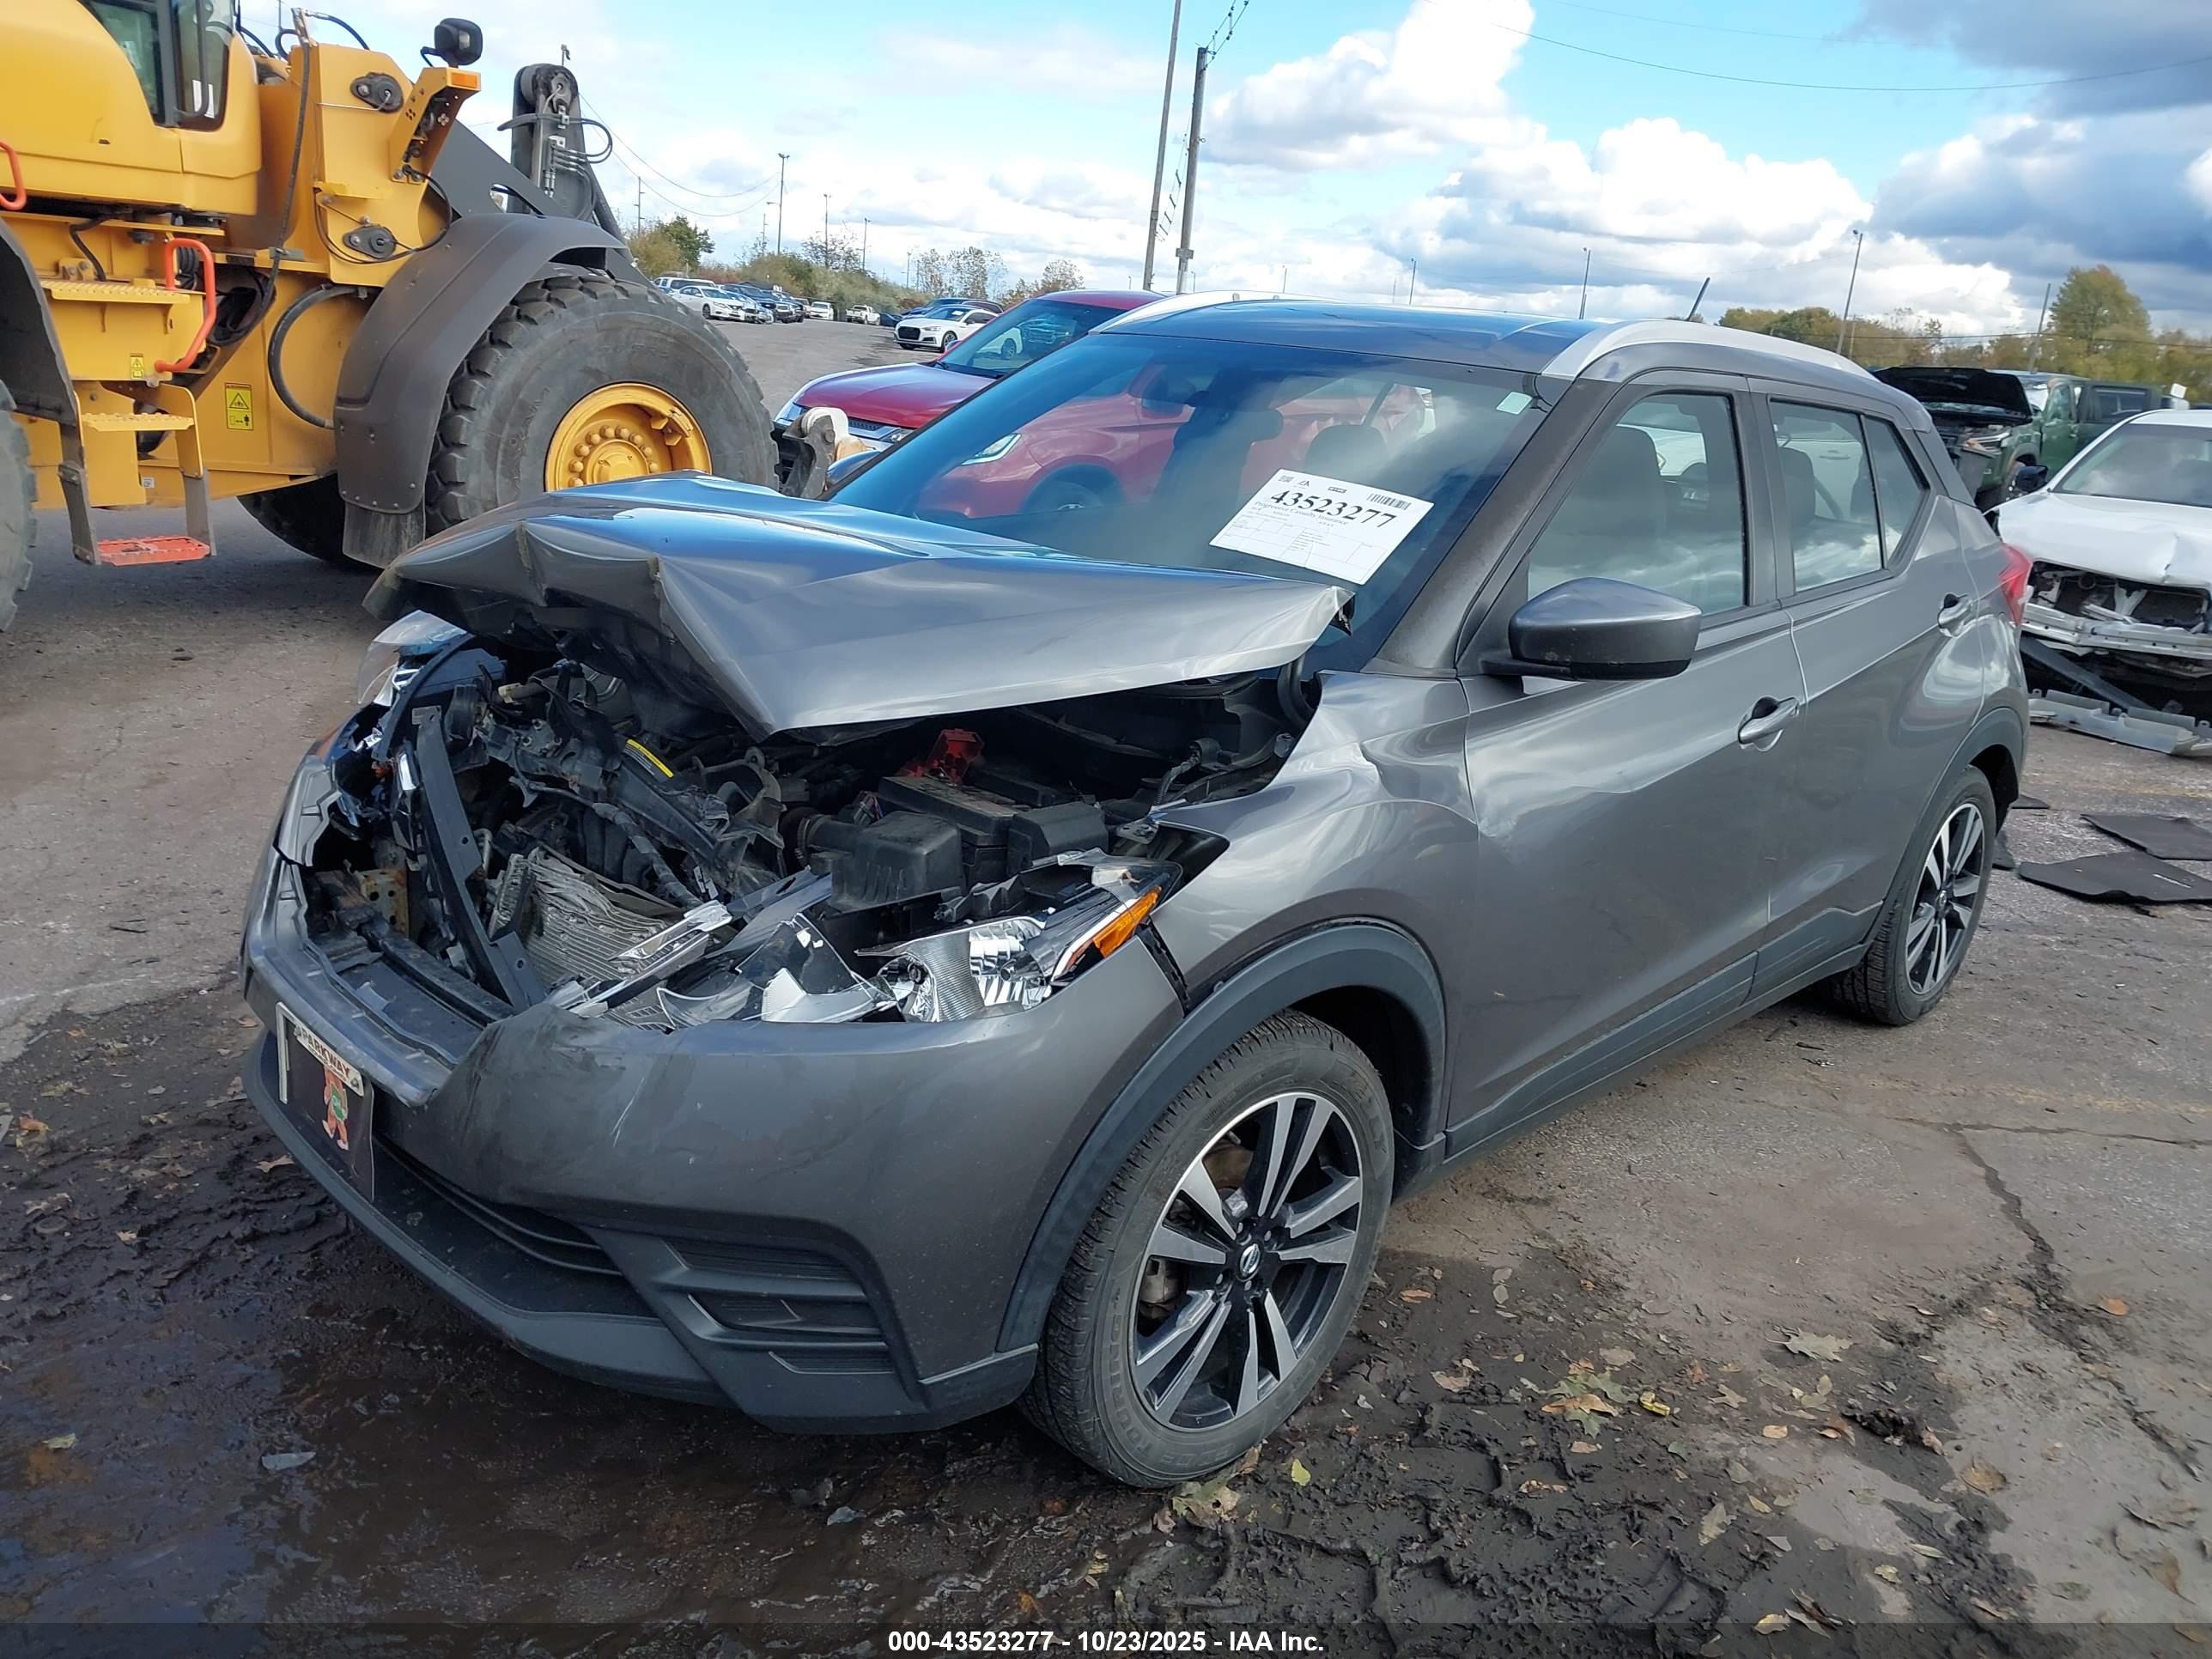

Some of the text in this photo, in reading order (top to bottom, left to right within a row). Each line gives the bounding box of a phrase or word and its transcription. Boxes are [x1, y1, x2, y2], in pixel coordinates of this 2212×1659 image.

[1270, 489, 1397, 528] 43523277
[301, 1027, 349, 1079] PARKWAY
[1109, 1314, 1153, 1456] TOURING
